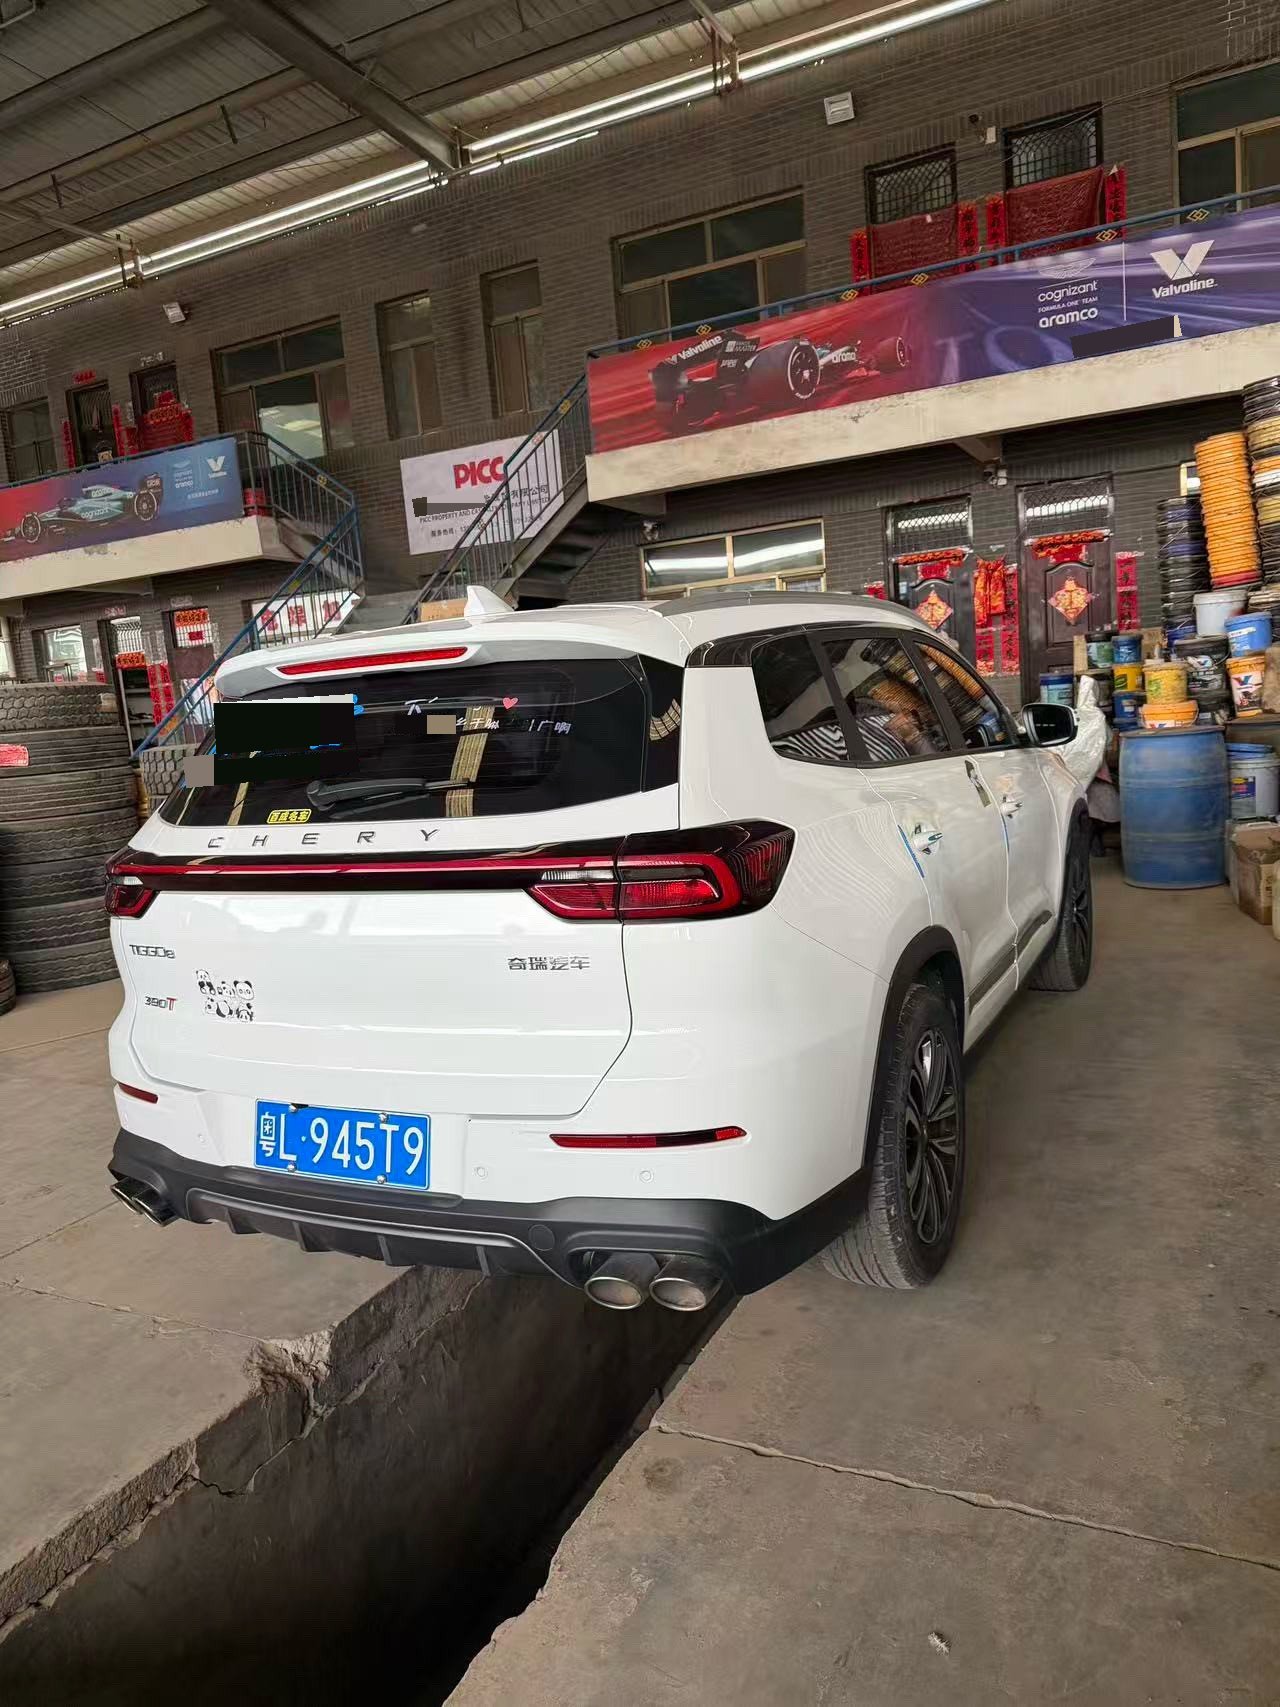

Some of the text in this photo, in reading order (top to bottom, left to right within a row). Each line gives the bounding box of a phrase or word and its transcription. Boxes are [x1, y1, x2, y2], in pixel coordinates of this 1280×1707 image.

[1038, 280, 1098, 302] cognizant
[1152, 278, 1215, 299] Valvoline
[1038, 303, 1066, 313] FORMULA
[1082, 296, 1098, 304] TEAM
[1038, 307, 1098, 328] aramco
[678, 335, 723, 360] Valvoline
[453, 456, 506, 489] PICC
[431, 511, 459, 522] PROPERTY
[459, 509, 470, 518] AND
[208, 829, 439, 848] CHERY
[507, 956, 591, 970] 奇瑞汽车
[145, 996, 177, 1011] 390T
